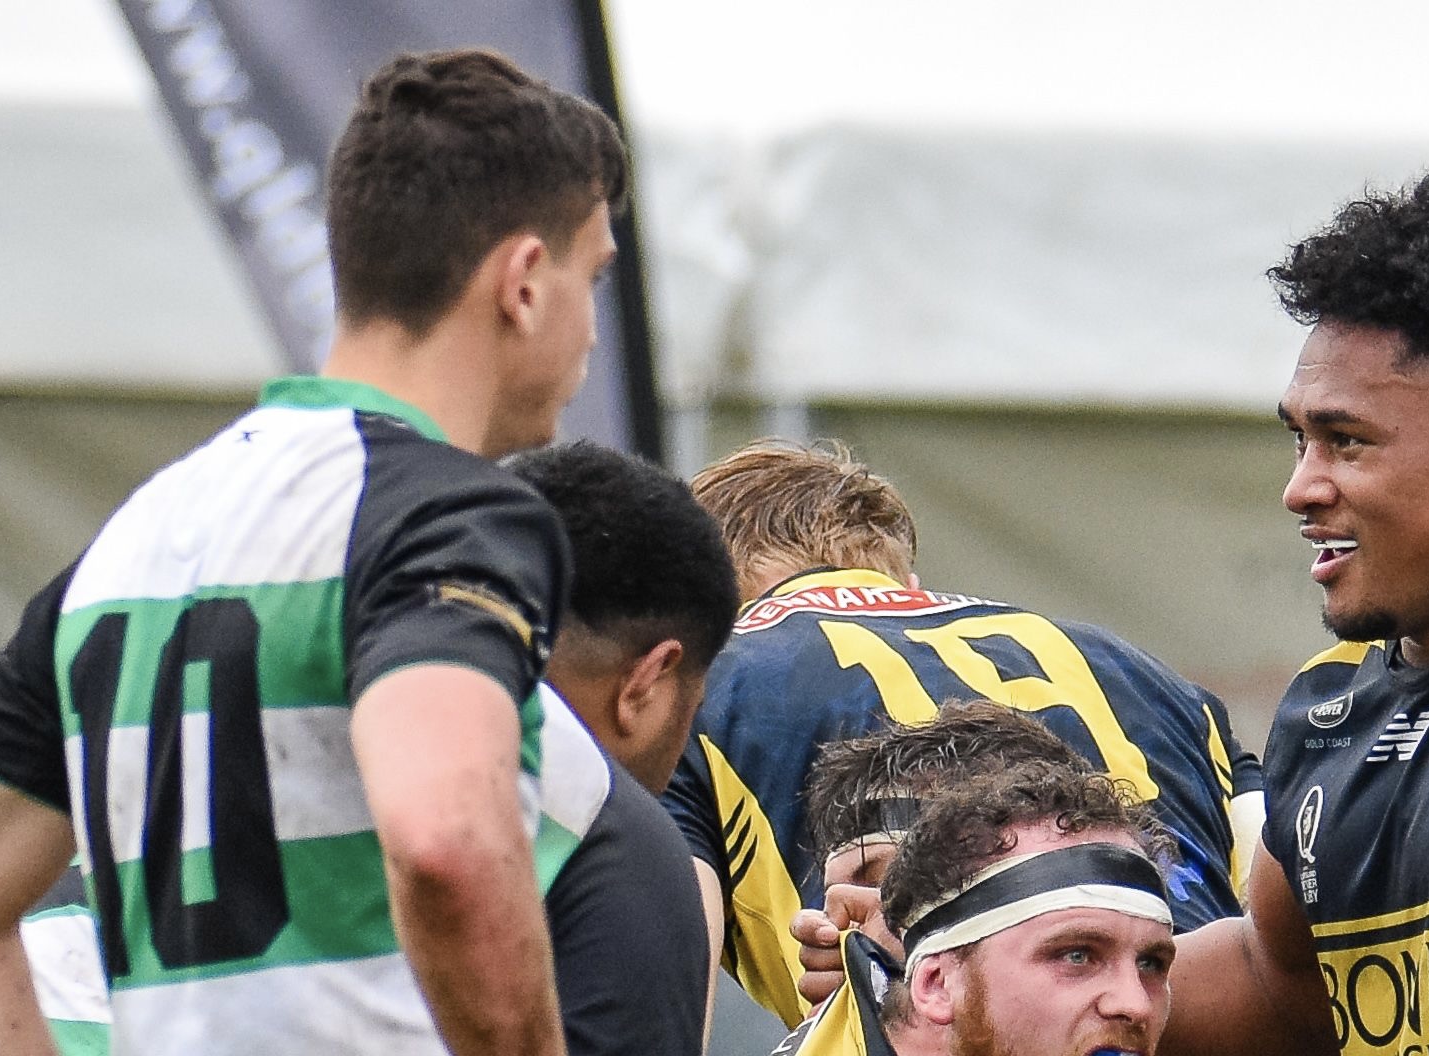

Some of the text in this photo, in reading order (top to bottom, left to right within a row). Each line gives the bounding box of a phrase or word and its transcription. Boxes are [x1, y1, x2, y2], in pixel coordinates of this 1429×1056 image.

[68, 598, 291, 976] 10
[829, 612, 1160, 802] 19
[1327, 737, 1351, 748] COAST
